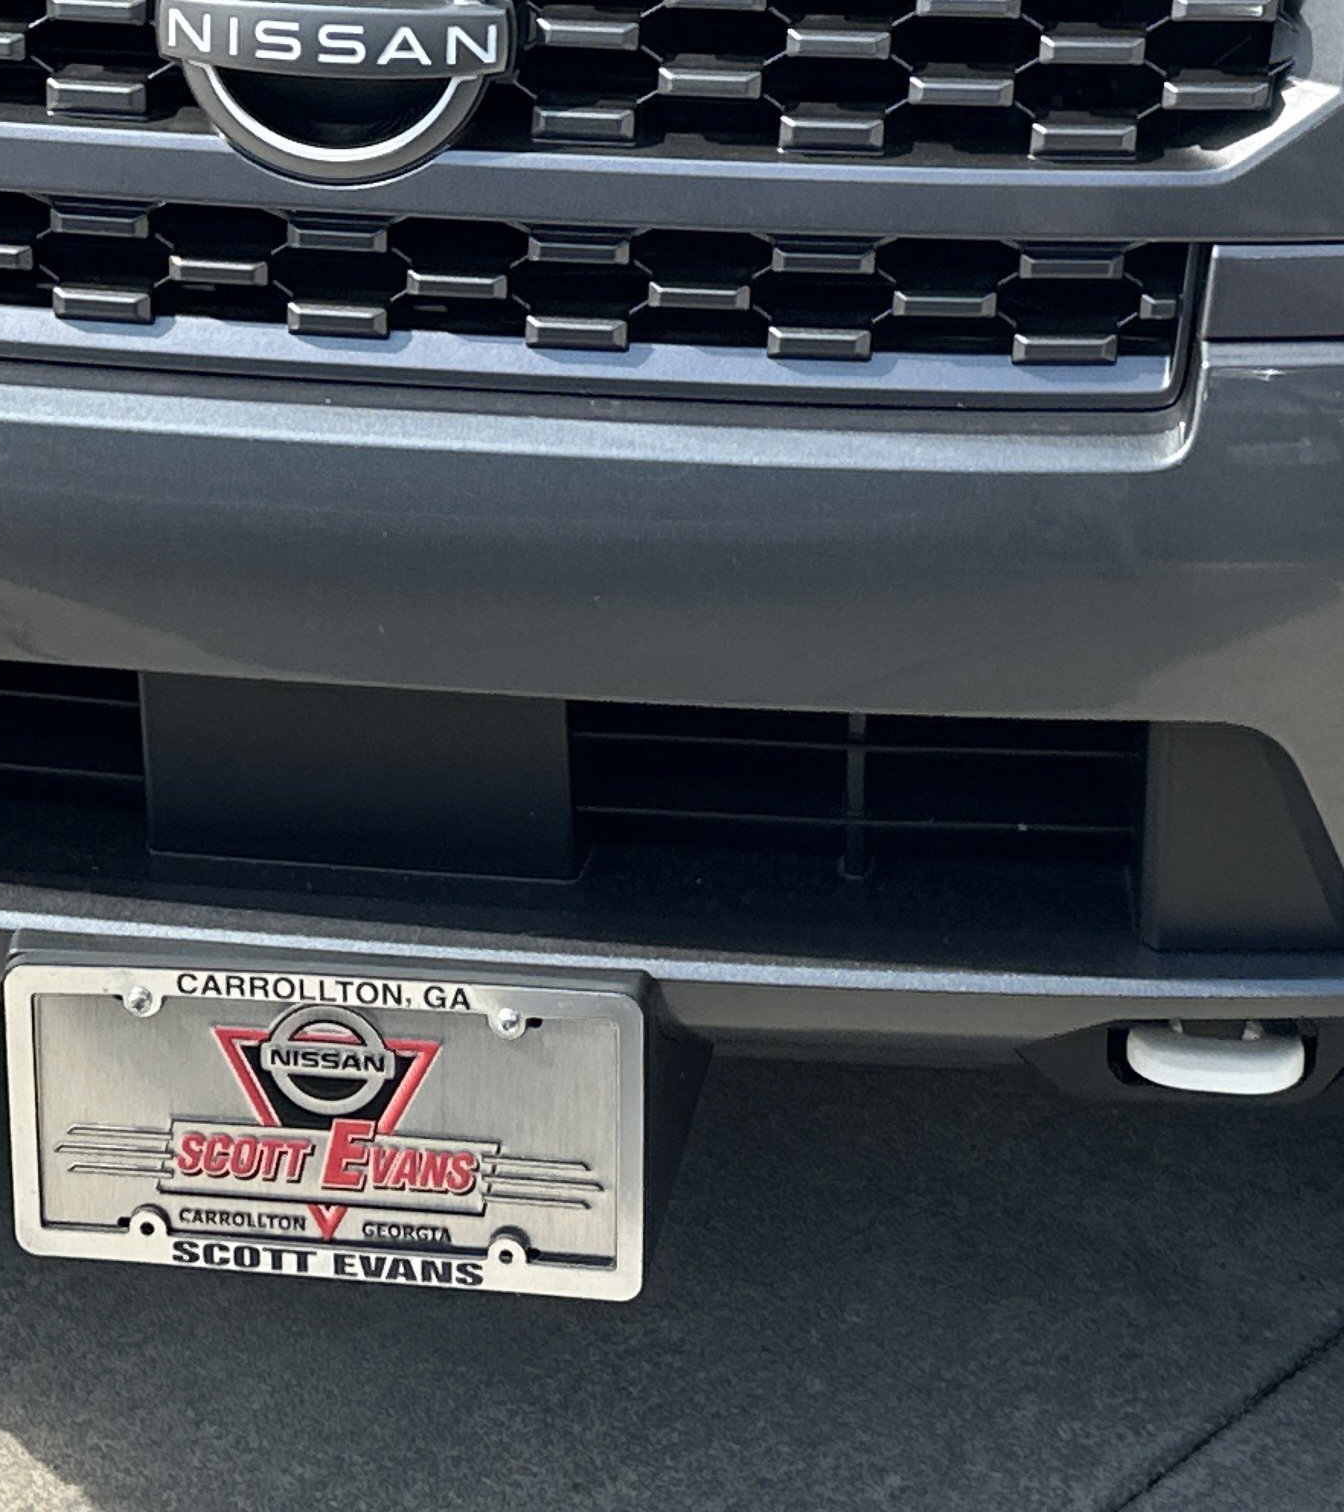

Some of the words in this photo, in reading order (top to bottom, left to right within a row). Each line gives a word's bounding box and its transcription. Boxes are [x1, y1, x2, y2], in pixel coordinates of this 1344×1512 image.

[166, 7, 498, 66] NISSAN
[176, 972, 413, 1008] CARROLLTON,
[423, 985, 472, 1011] GA
[270, 1047, 386, 1073] NISSAN
[175, 1131, 315, 1183] SCOTT
[320, 1118, 480, 1194] EVANS
[179, 1207, 307, 1232] CARROLLTON
[362, 1221, 452, 1243] GEORGIA
[172, 1240, 318, 1272] SCOTT
[333, 1252, 484, 1286] EVANS
